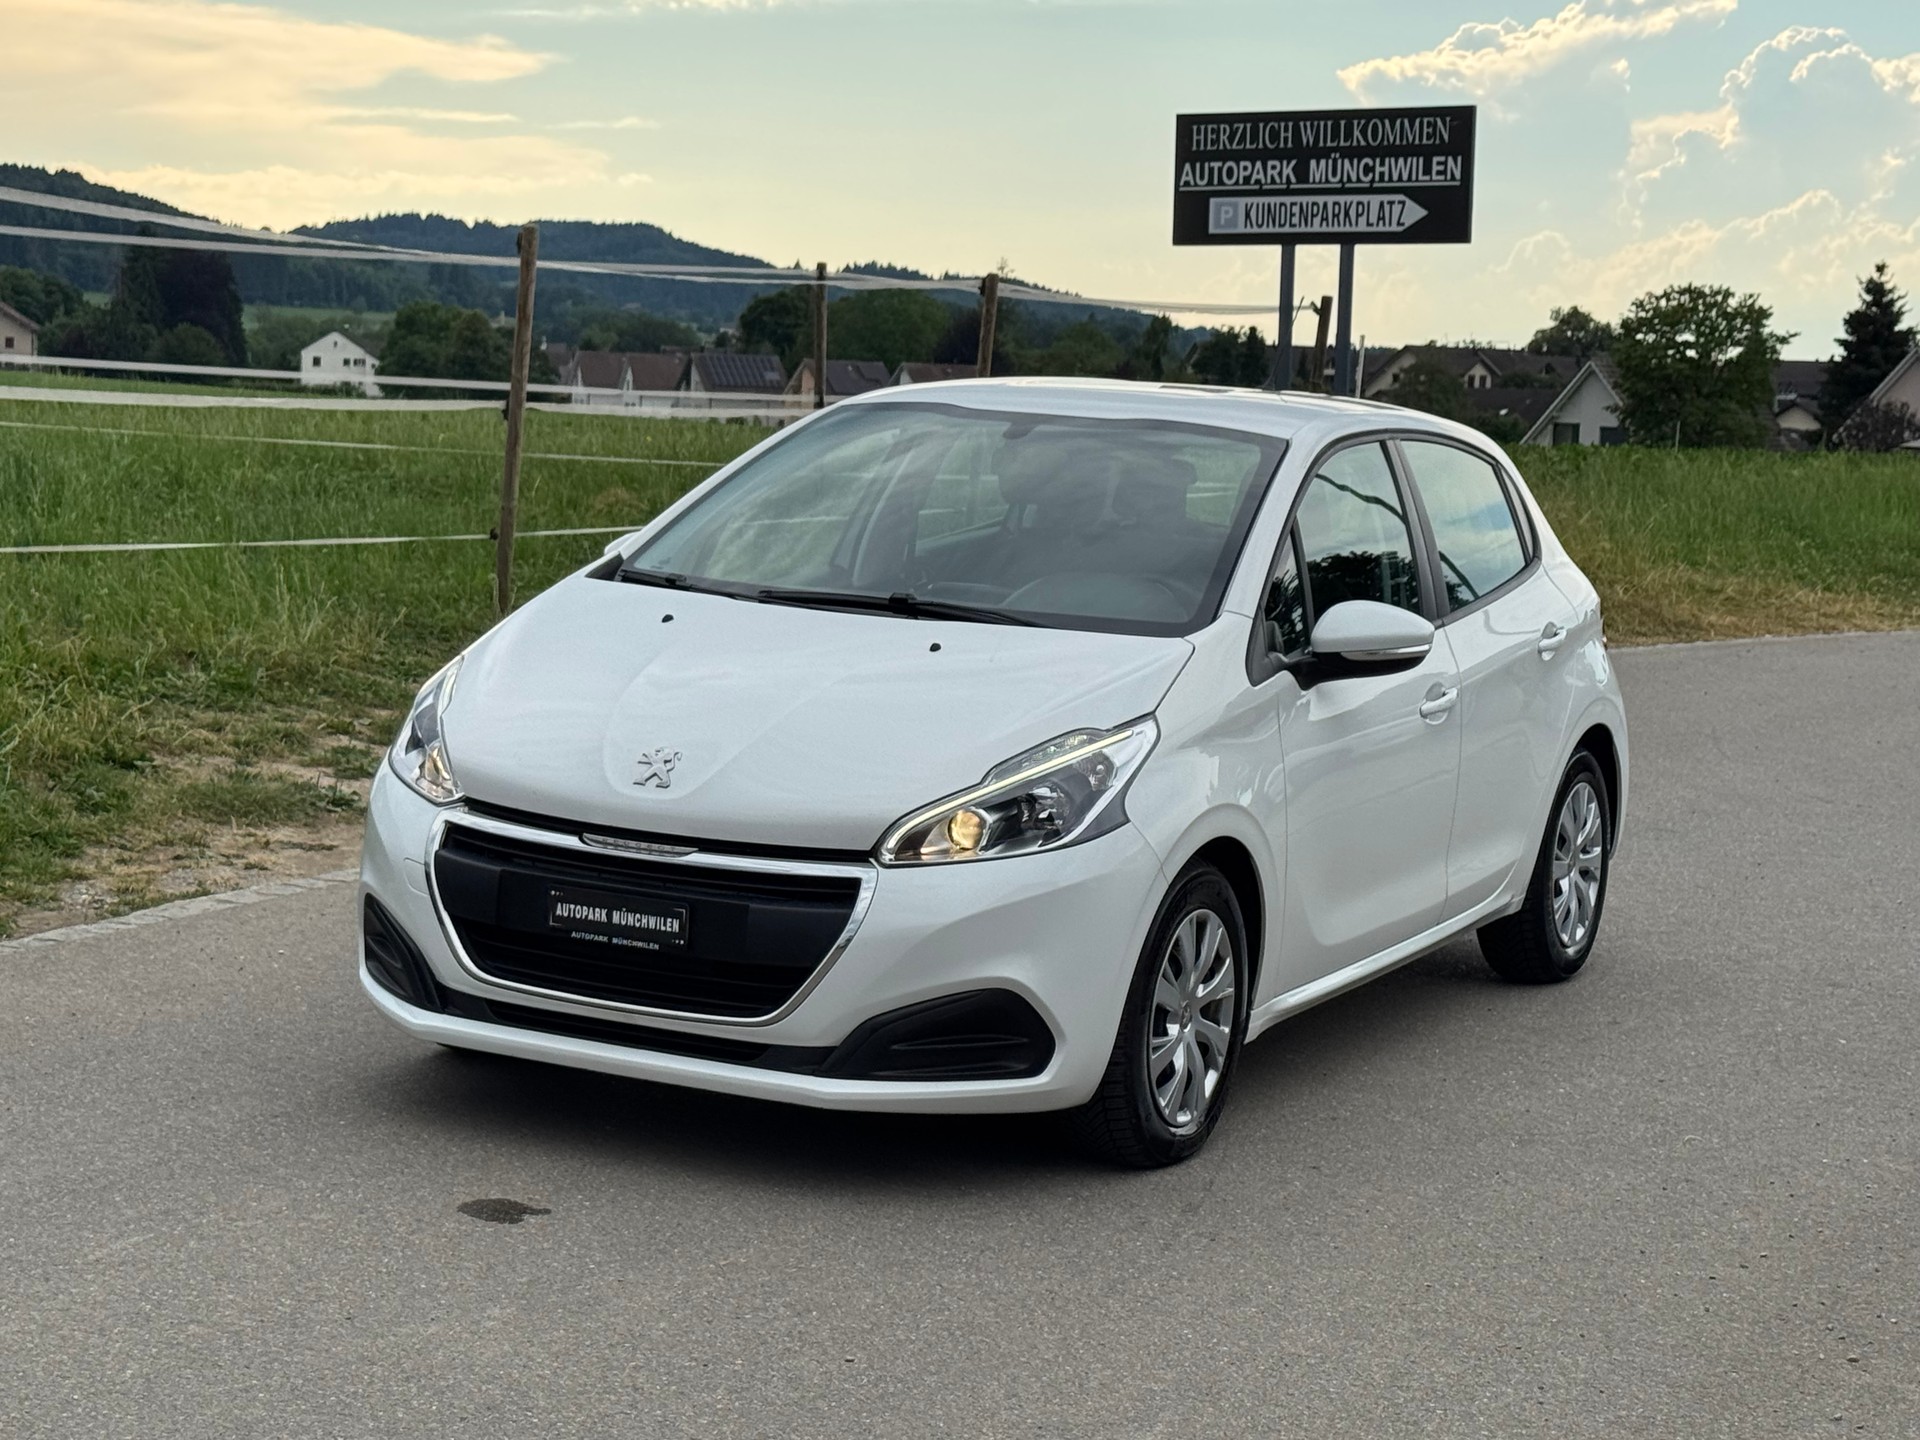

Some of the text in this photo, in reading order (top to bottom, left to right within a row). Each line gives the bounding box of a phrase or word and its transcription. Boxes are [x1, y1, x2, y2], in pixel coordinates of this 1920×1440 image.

[1191, 116, 1452, 151] HERZLICH WILLKOMMEN
[1179, 153, 1462, 186] AUTOPARK MÜNCHWILEN
[1220, 200, 1407, 229] P KUNDENPARKPLATZ
[555, 902, 680, 933] AUTOPARK MÜNCHWILEN
[571, 930, 660, 951] AUTOPARK MÜNCHWILEN
